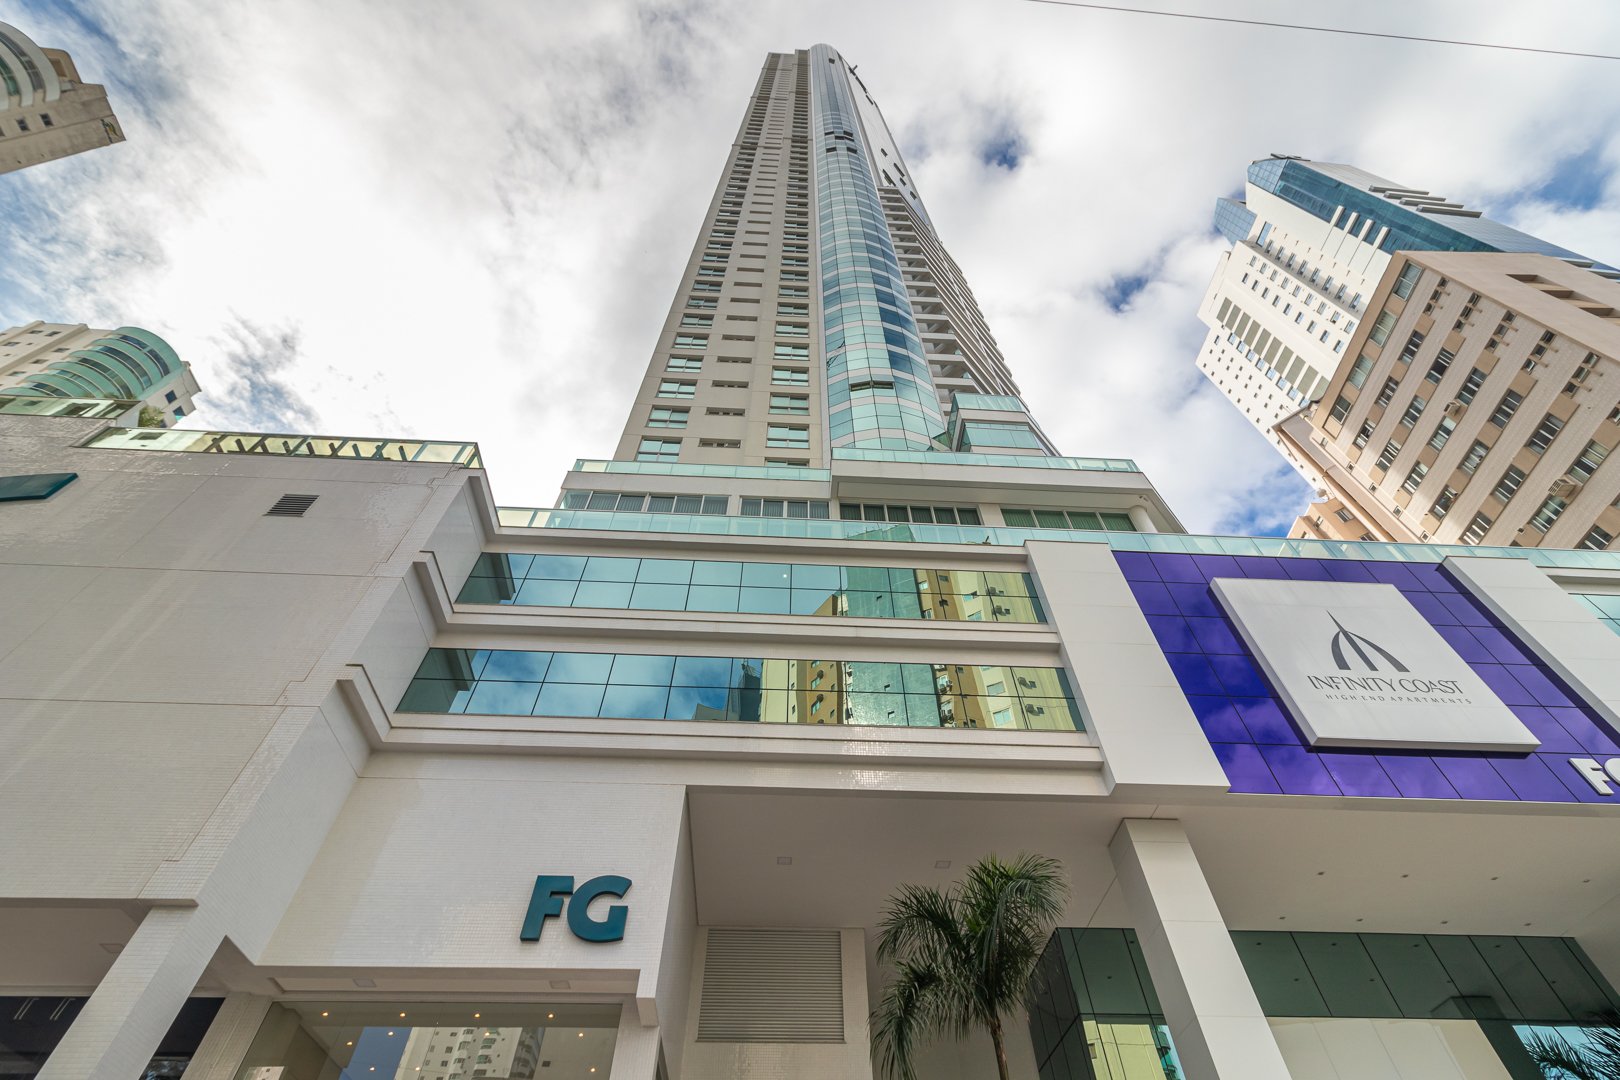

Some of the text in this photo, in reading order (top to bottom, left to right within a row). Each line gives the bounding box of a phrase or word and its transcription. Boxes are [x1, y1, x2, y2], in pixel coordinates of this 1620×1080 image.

[1307, 675, 1464, 695] INFINITY COAST
[1326, 693, 1358, 702] HIGH
[1390, 696, 1473, 705] APARTMENTS
[520, 874, 633, 943] FG
